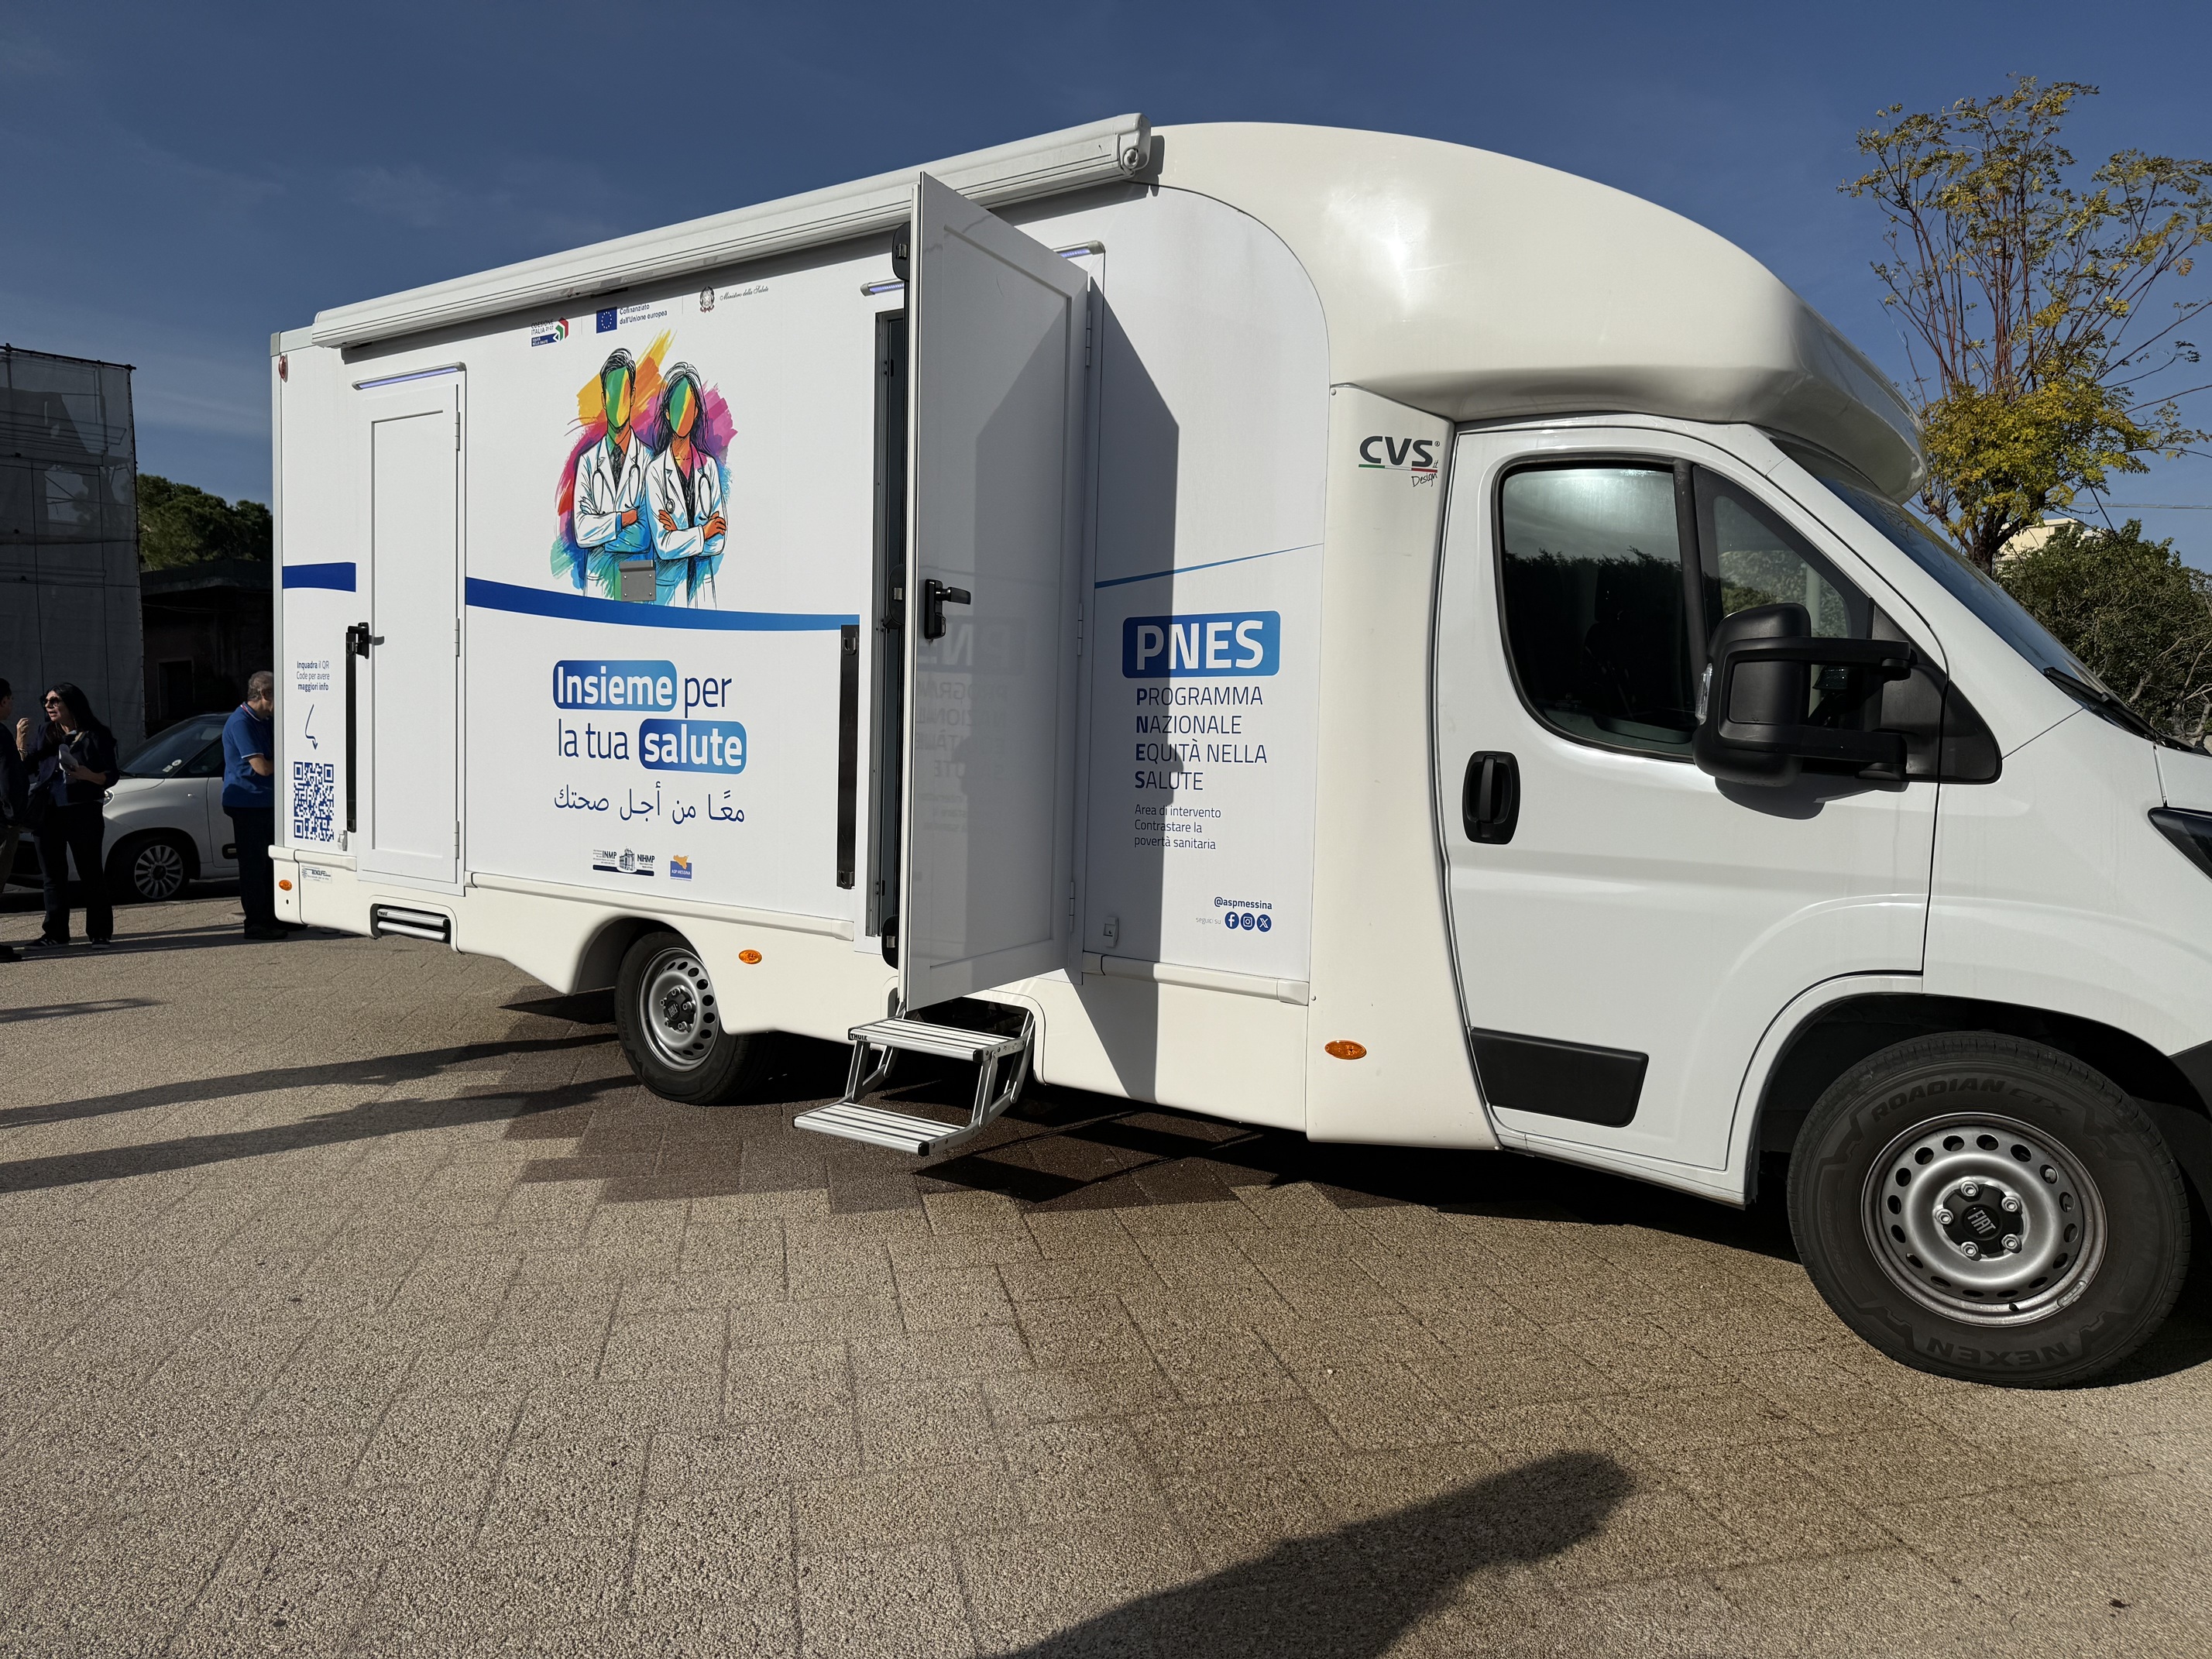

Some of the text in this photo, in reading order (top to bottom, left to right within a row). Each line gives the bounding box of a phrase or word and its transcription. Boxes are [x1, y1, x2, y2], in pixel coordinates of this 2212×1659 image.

[619, 304, 650, 315] Cofinanziato
[647, 311, 668, 320] europea
[531, 327, 545, 335] ITALIA
[1359, 435, 1434, 467] CVS
[1411, 472, 1438, 487] Design
[1136, 620, 1264, 670] PNES
[297, 661, 318, 671] Inquadra
[322, 661, 330, 670] QR
[296, 671, 308, 680] Code
[297, 682, 318, 692] maggiori
[558, 665, 732, 719] Insieme per
[1136, 686, 1263, 706] PROGRAMMA
[1136, 716, 1242, 734] NAZIONALE
[558, 718, 742, 766] la tua salute
[1135, 738, 1267, 764] EQUITÀ NELLA
[1135, 771, 1204, 791] SALUTE
[554, 784, 610, 811] صحتك
[620, 781, 661, 822] أجل
[672, 800, 696, 825] من
[1135, 804, 1221, 819] Area di intervento
[1135, 819, 1202, 833] Contrastare la
[1134, 836, 1216, 850] povertà sanitaria
[602, 850, 617, 860] INMP
[637, 854, 655, 864] NIHMP
[1214, 896, 1273, 909] @aspmessina
[1870, 1077, 2005, 1123] ROADIAN
[1967, 1210, 1996, 1234] FIAT
[1926, 1337, 2069, 1366] NEXEN
